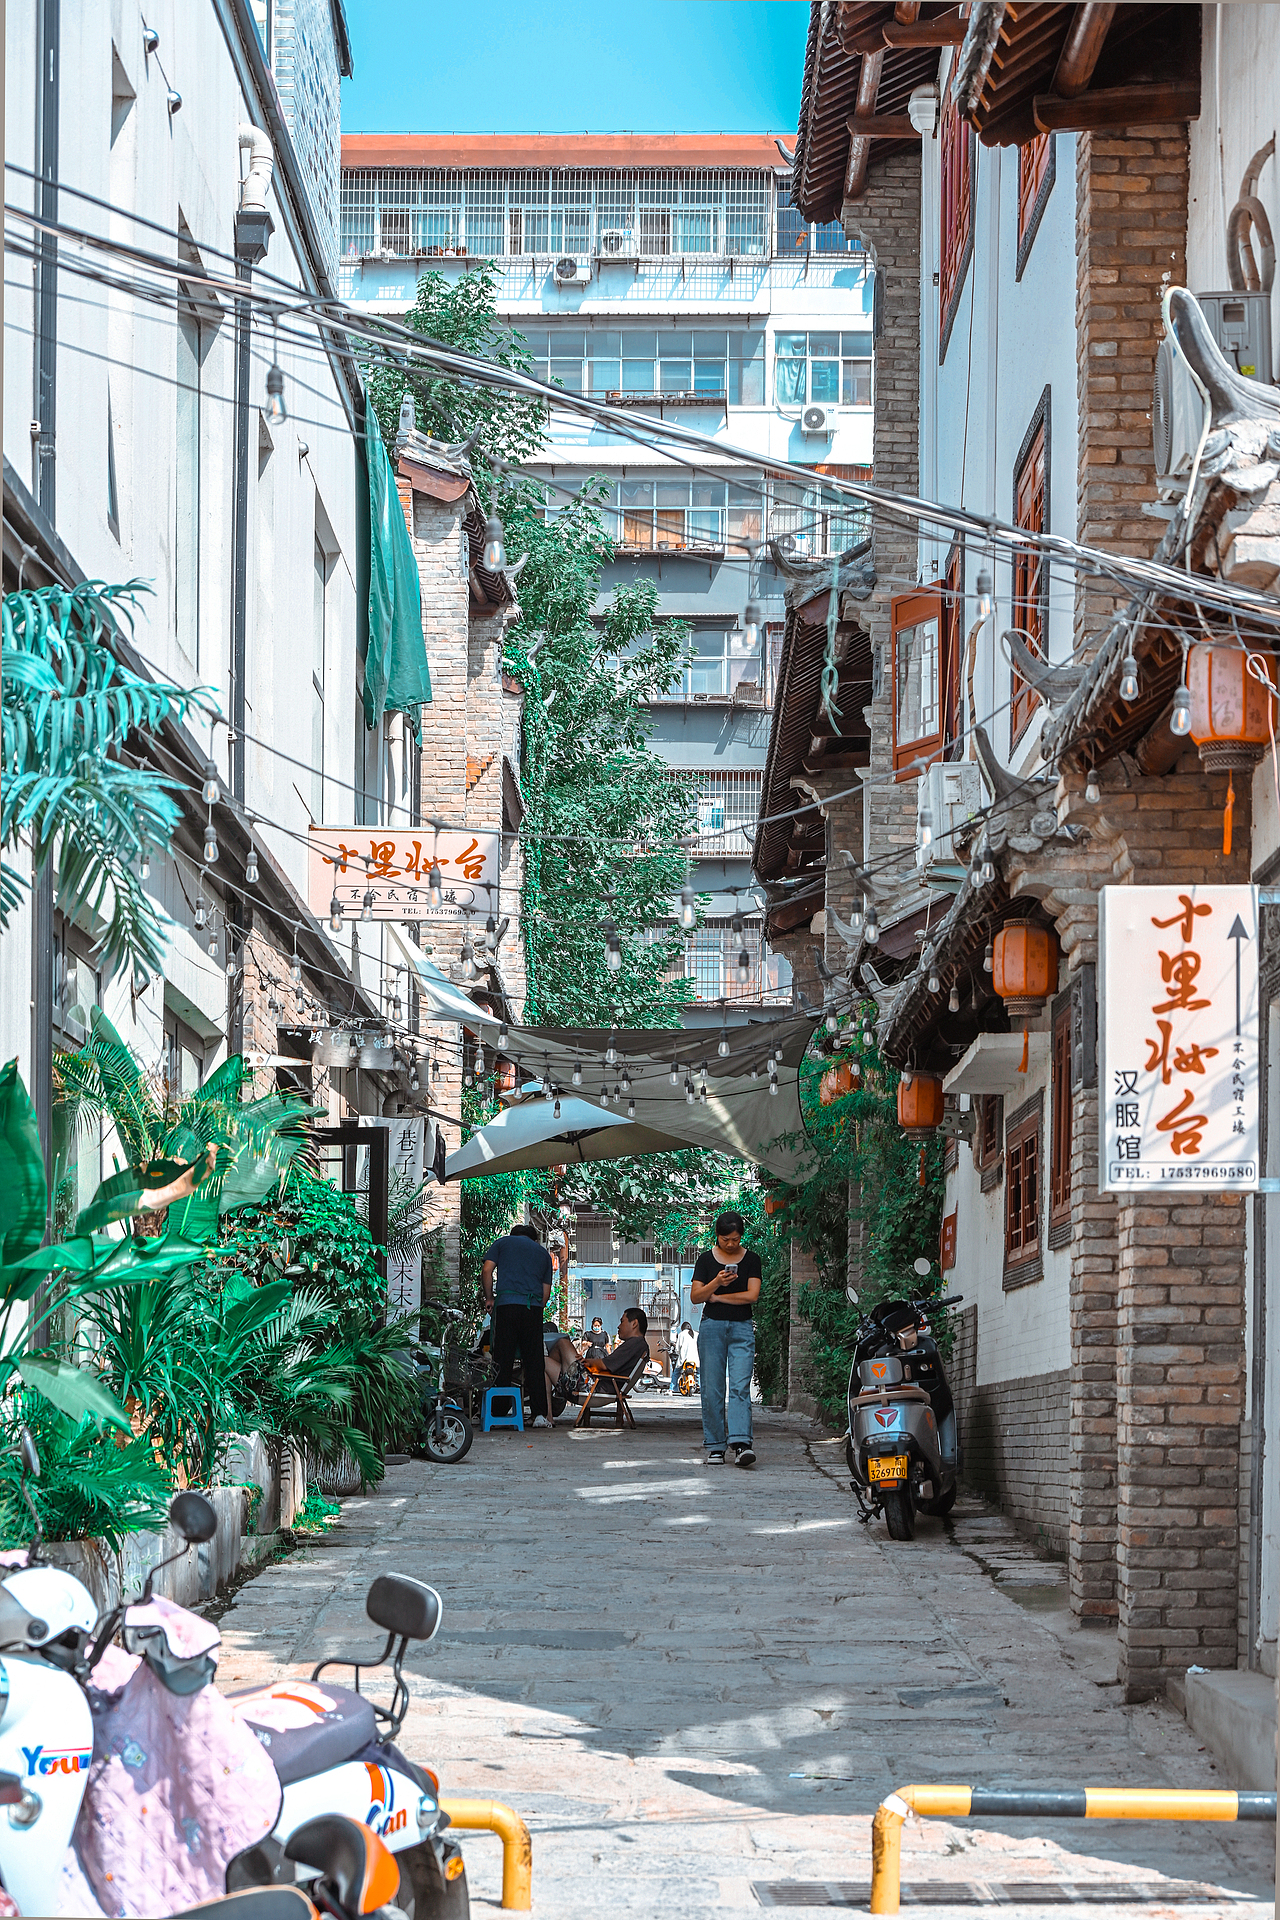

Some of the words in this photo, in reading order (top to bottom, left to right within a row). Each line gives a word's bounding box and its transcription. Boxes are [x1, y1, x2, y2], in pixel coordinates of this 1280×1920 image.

[1144, 894, 1219, 1155] 十里妆台
[1114, 1070, 1141, 1160] 汉服馆
[1114, 1167, 1150, 1179] TEL:
[1161, 1167, 1253, 1179] 17537969580
[871, 1467, 905, 1479] 3269700
